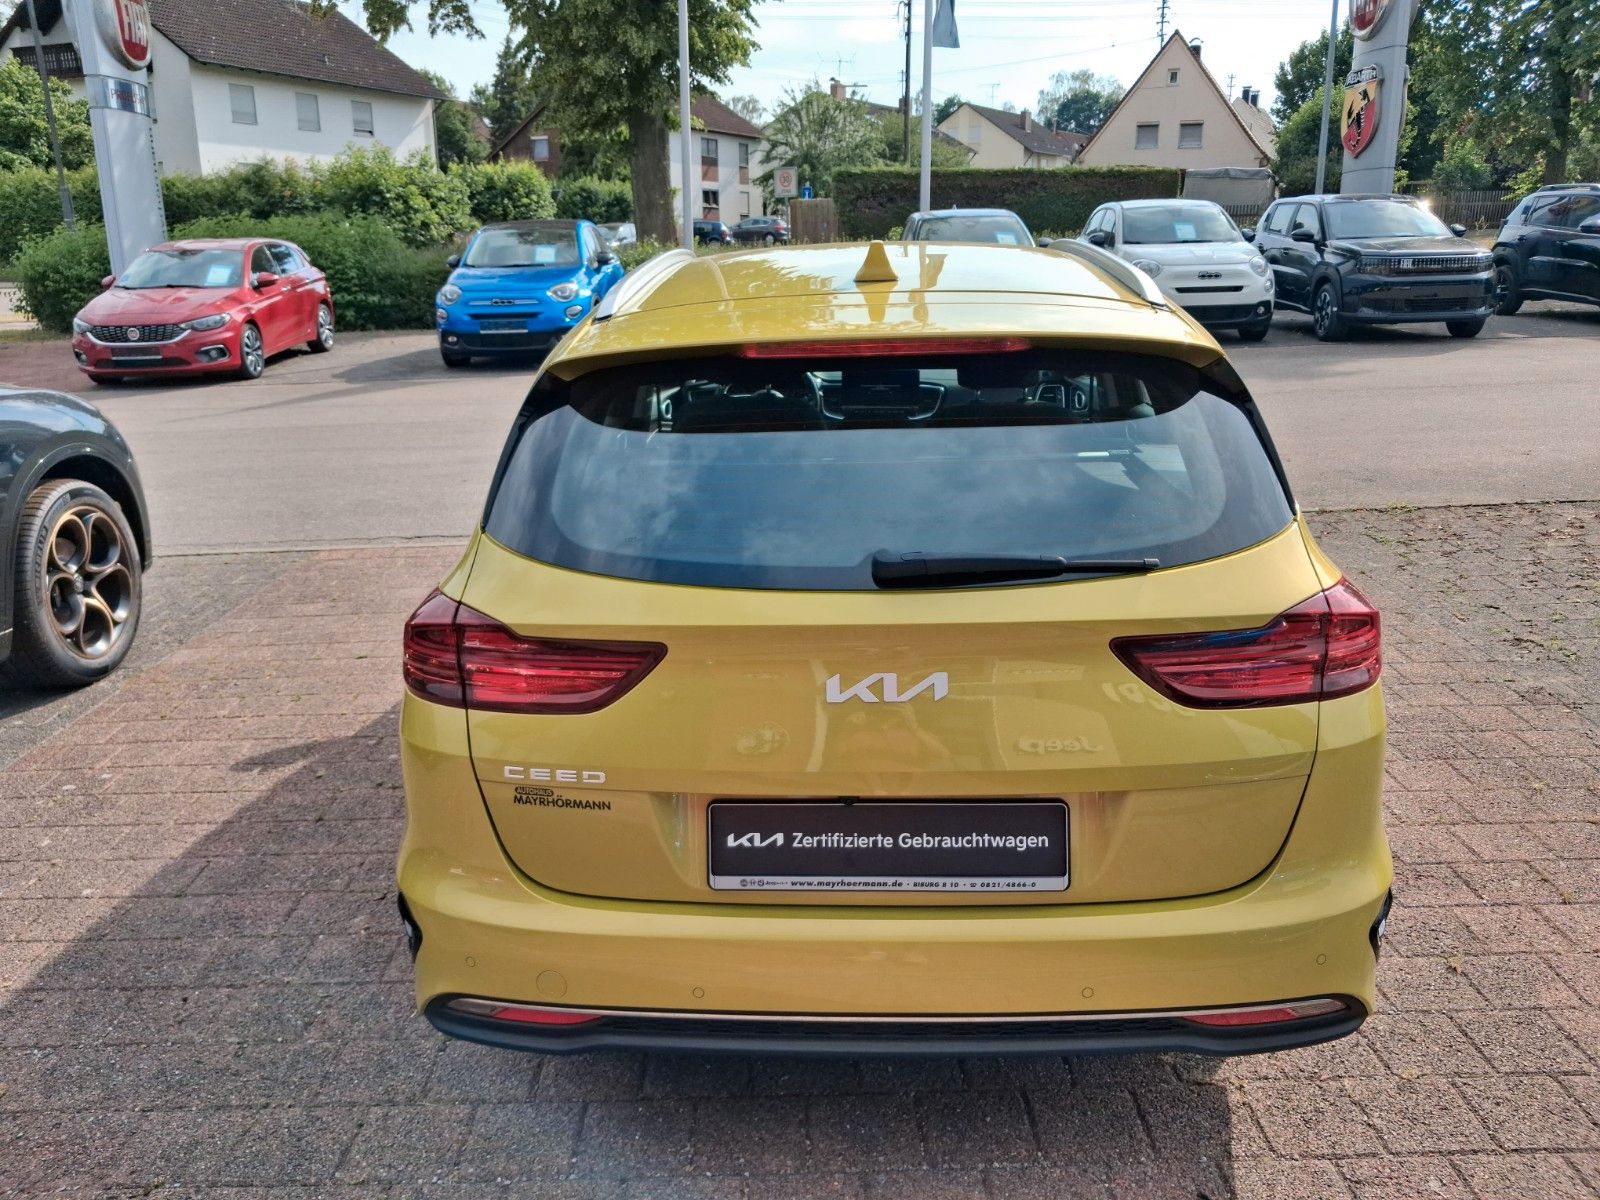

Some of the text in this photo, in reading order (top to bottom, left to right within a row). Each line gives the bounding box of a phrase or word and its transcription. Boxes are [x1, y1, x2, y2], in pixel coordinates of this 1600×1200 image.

[1346, 68, 1377, 87] ABARTH
[825, 672, 949, 703] KIA
[504, 765, 607, 784] CEED
[516, 787, 553, 797] AUTOHAUS
[513, 794, 611, 811] MAYRHÖRMANN
[727, 832, 1049, 851] KIA Zertifizierte Gebrauchtwagen
[790, 879, 903, 889] www.mayrhoermann.de
